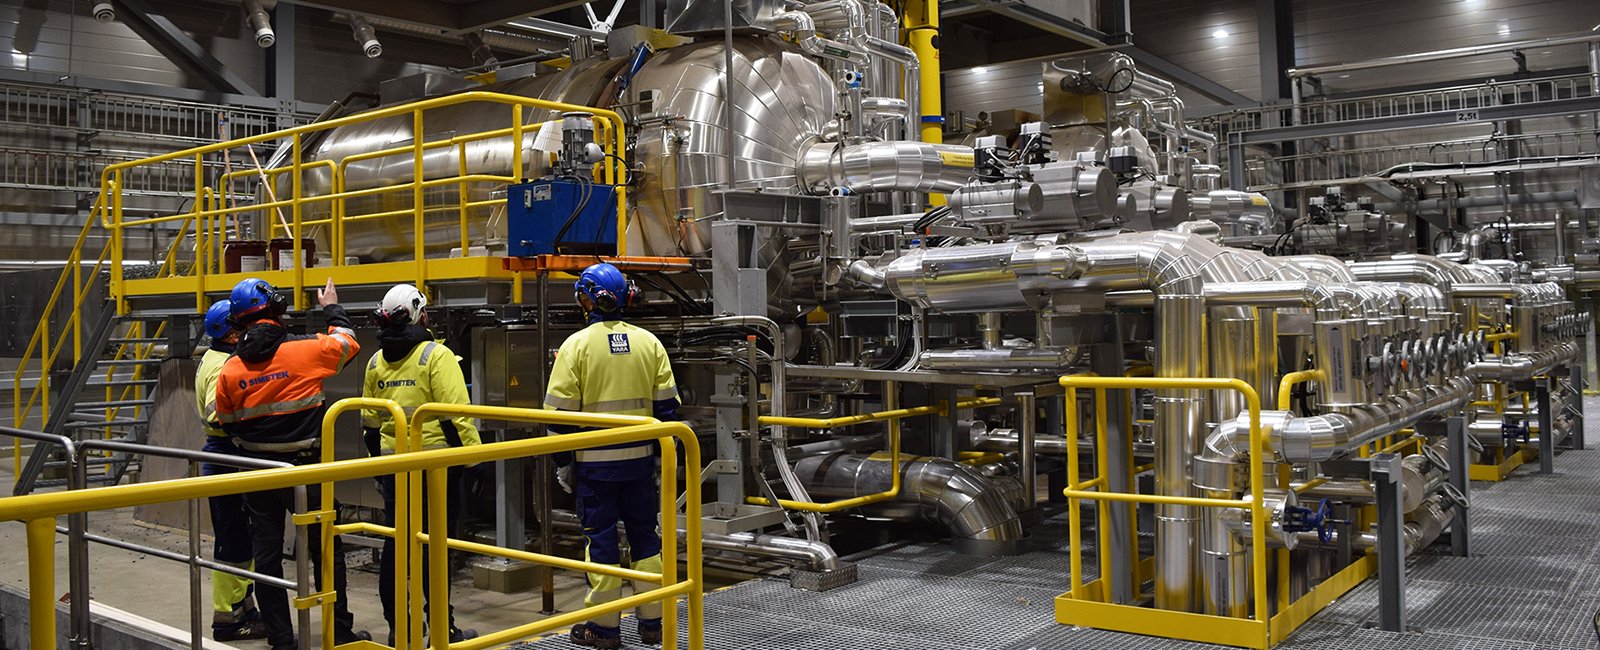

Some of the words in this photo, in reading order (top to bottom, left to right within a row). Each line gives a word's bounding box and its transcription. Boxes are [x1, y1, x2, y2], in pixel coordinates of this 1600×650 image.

[1458, 112, 1477, 121] 2,5t
[248, 370, 289, 387] SIMETEK
[385, 379, 416, 388] SIMETEK
